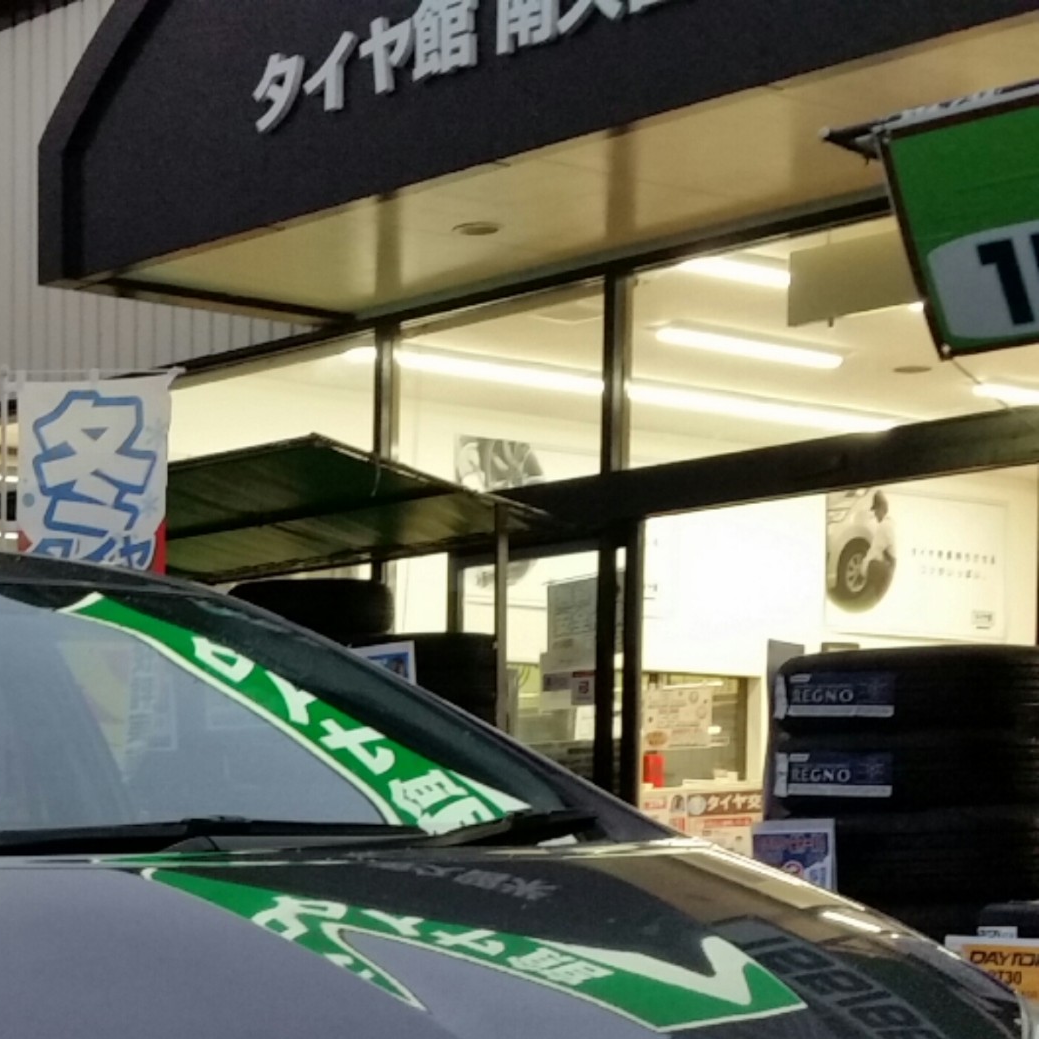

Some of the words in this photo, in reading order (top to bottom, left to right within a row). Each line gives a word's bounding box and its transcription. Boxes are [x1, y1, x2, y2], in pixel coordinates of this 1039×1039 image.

[250, 0, 480, 134] タイヤ館
[976, 233, 1039, 325] 1
[32, 389, 157, 538] 冬
[792, 688, 854, 702] REGNO
[791, 768, 851, 782] REGNO
